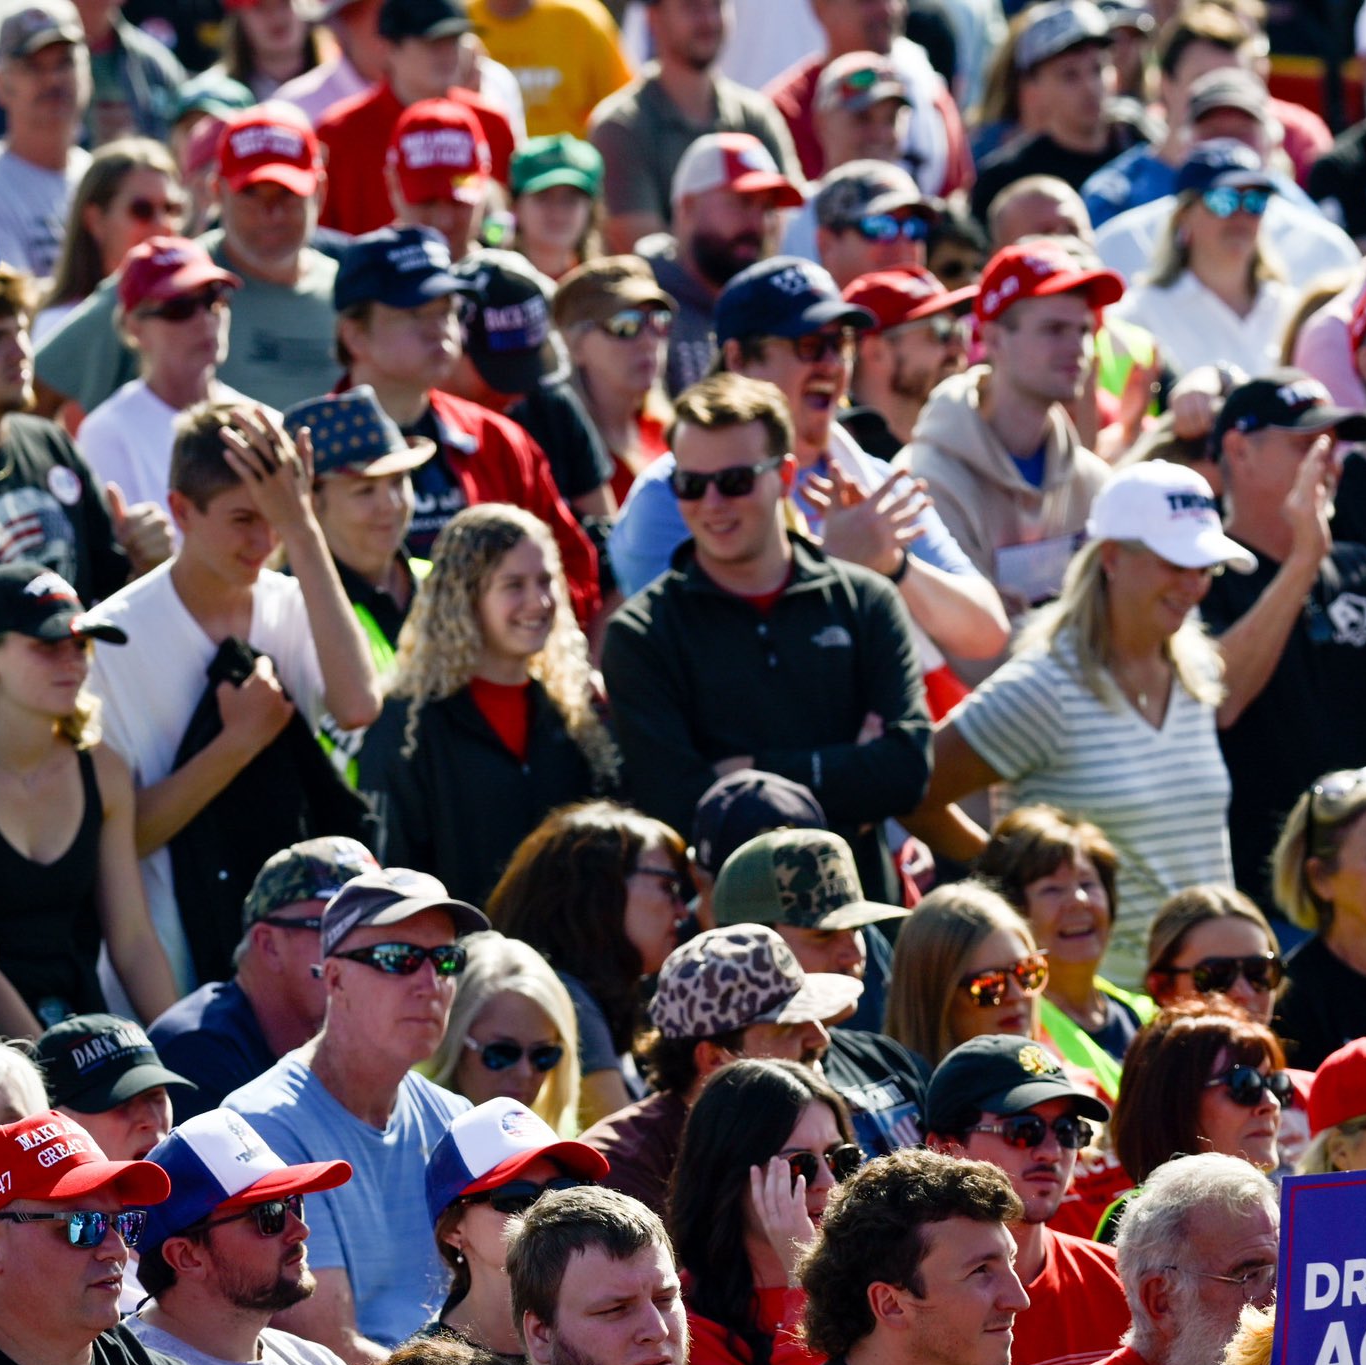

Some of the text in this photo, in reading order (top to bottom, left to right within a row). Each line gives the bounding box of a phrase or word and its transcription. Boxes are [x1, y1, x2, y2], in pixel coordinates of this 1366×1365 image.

[71, 1033, 120, 1070] DARK
[14, 1131, 66, 1152] MAKE
[37, 1136, 88, 1169] GREAT
